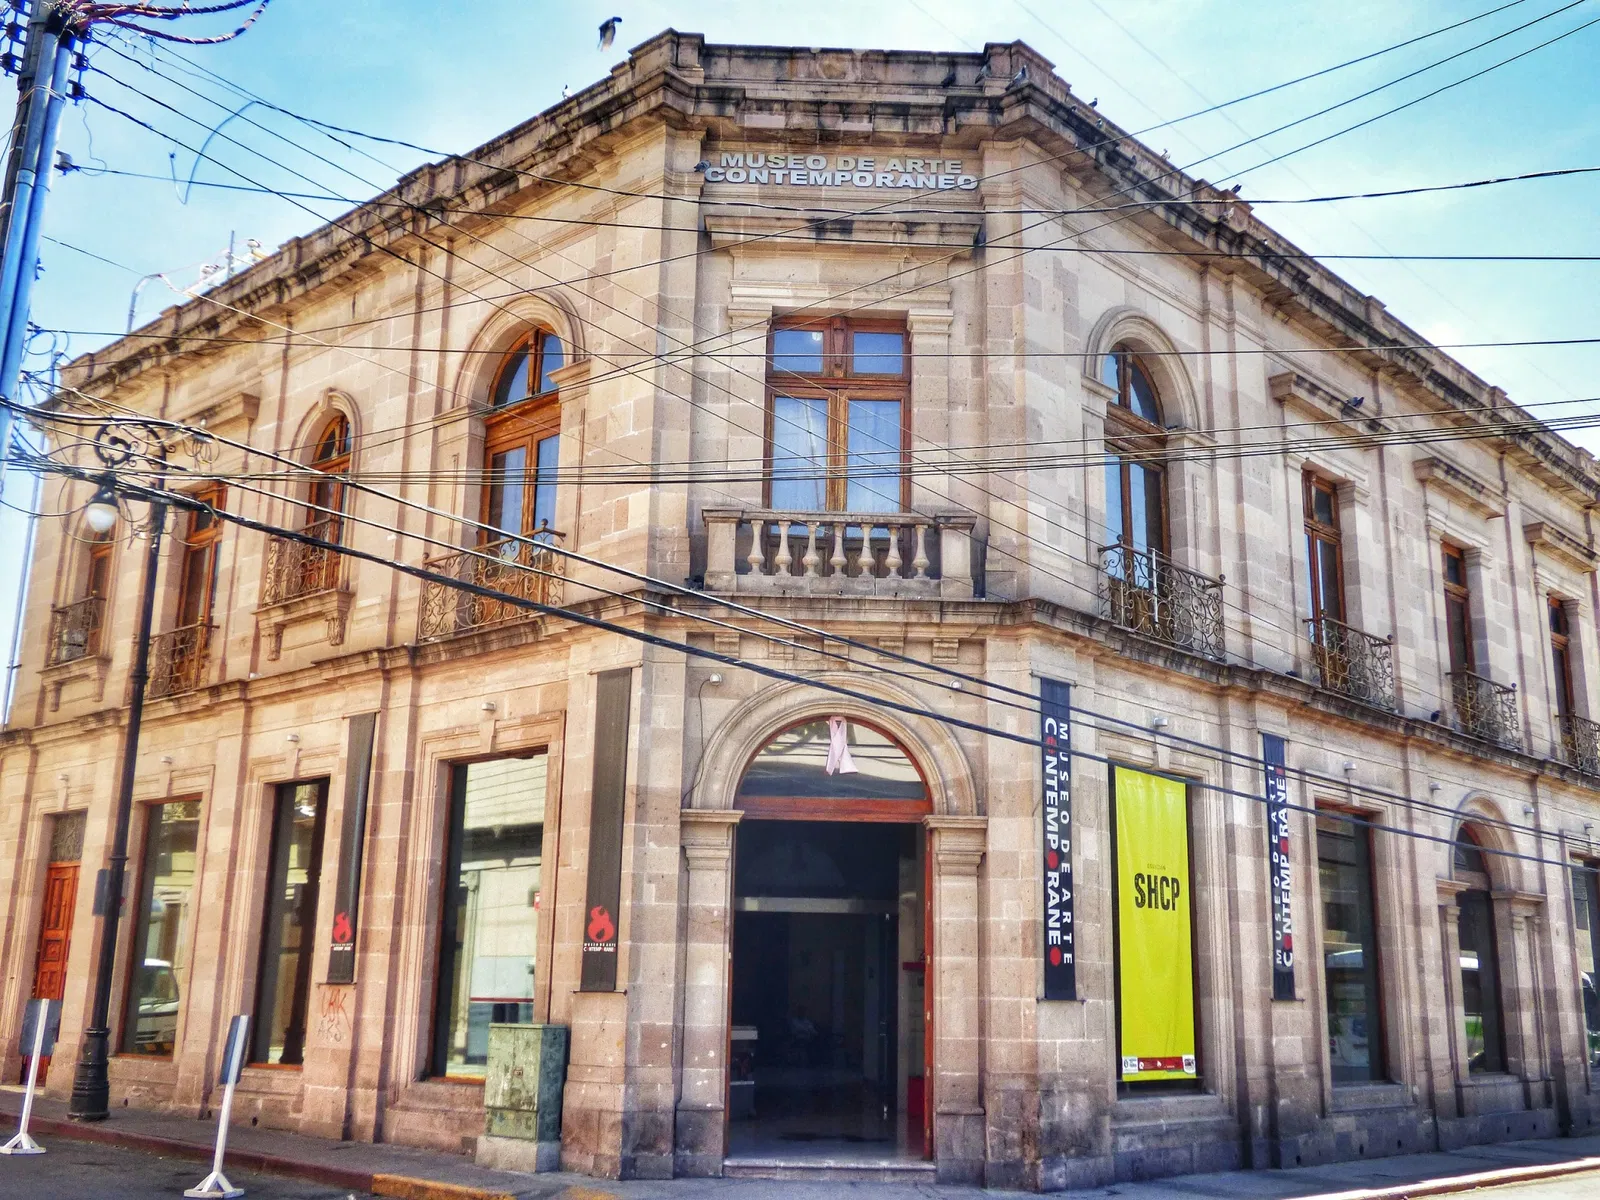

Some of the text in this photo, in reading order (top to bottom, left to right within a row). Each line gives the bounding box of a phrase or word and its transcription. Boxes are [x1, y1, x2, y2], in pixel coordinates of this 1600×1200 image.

[704, 167, 980, 191] CONTEMPORANEO
[720, 153, 963, 174] MUSEO DE ARTE
[1059, 722, 1073, 964] MUSEO DE ARTE
[1272, 834, 1279, 864] DE
[1134, 872, 1180, 911] SHCP
[1273, 875, 1282, 965] MUSEO
